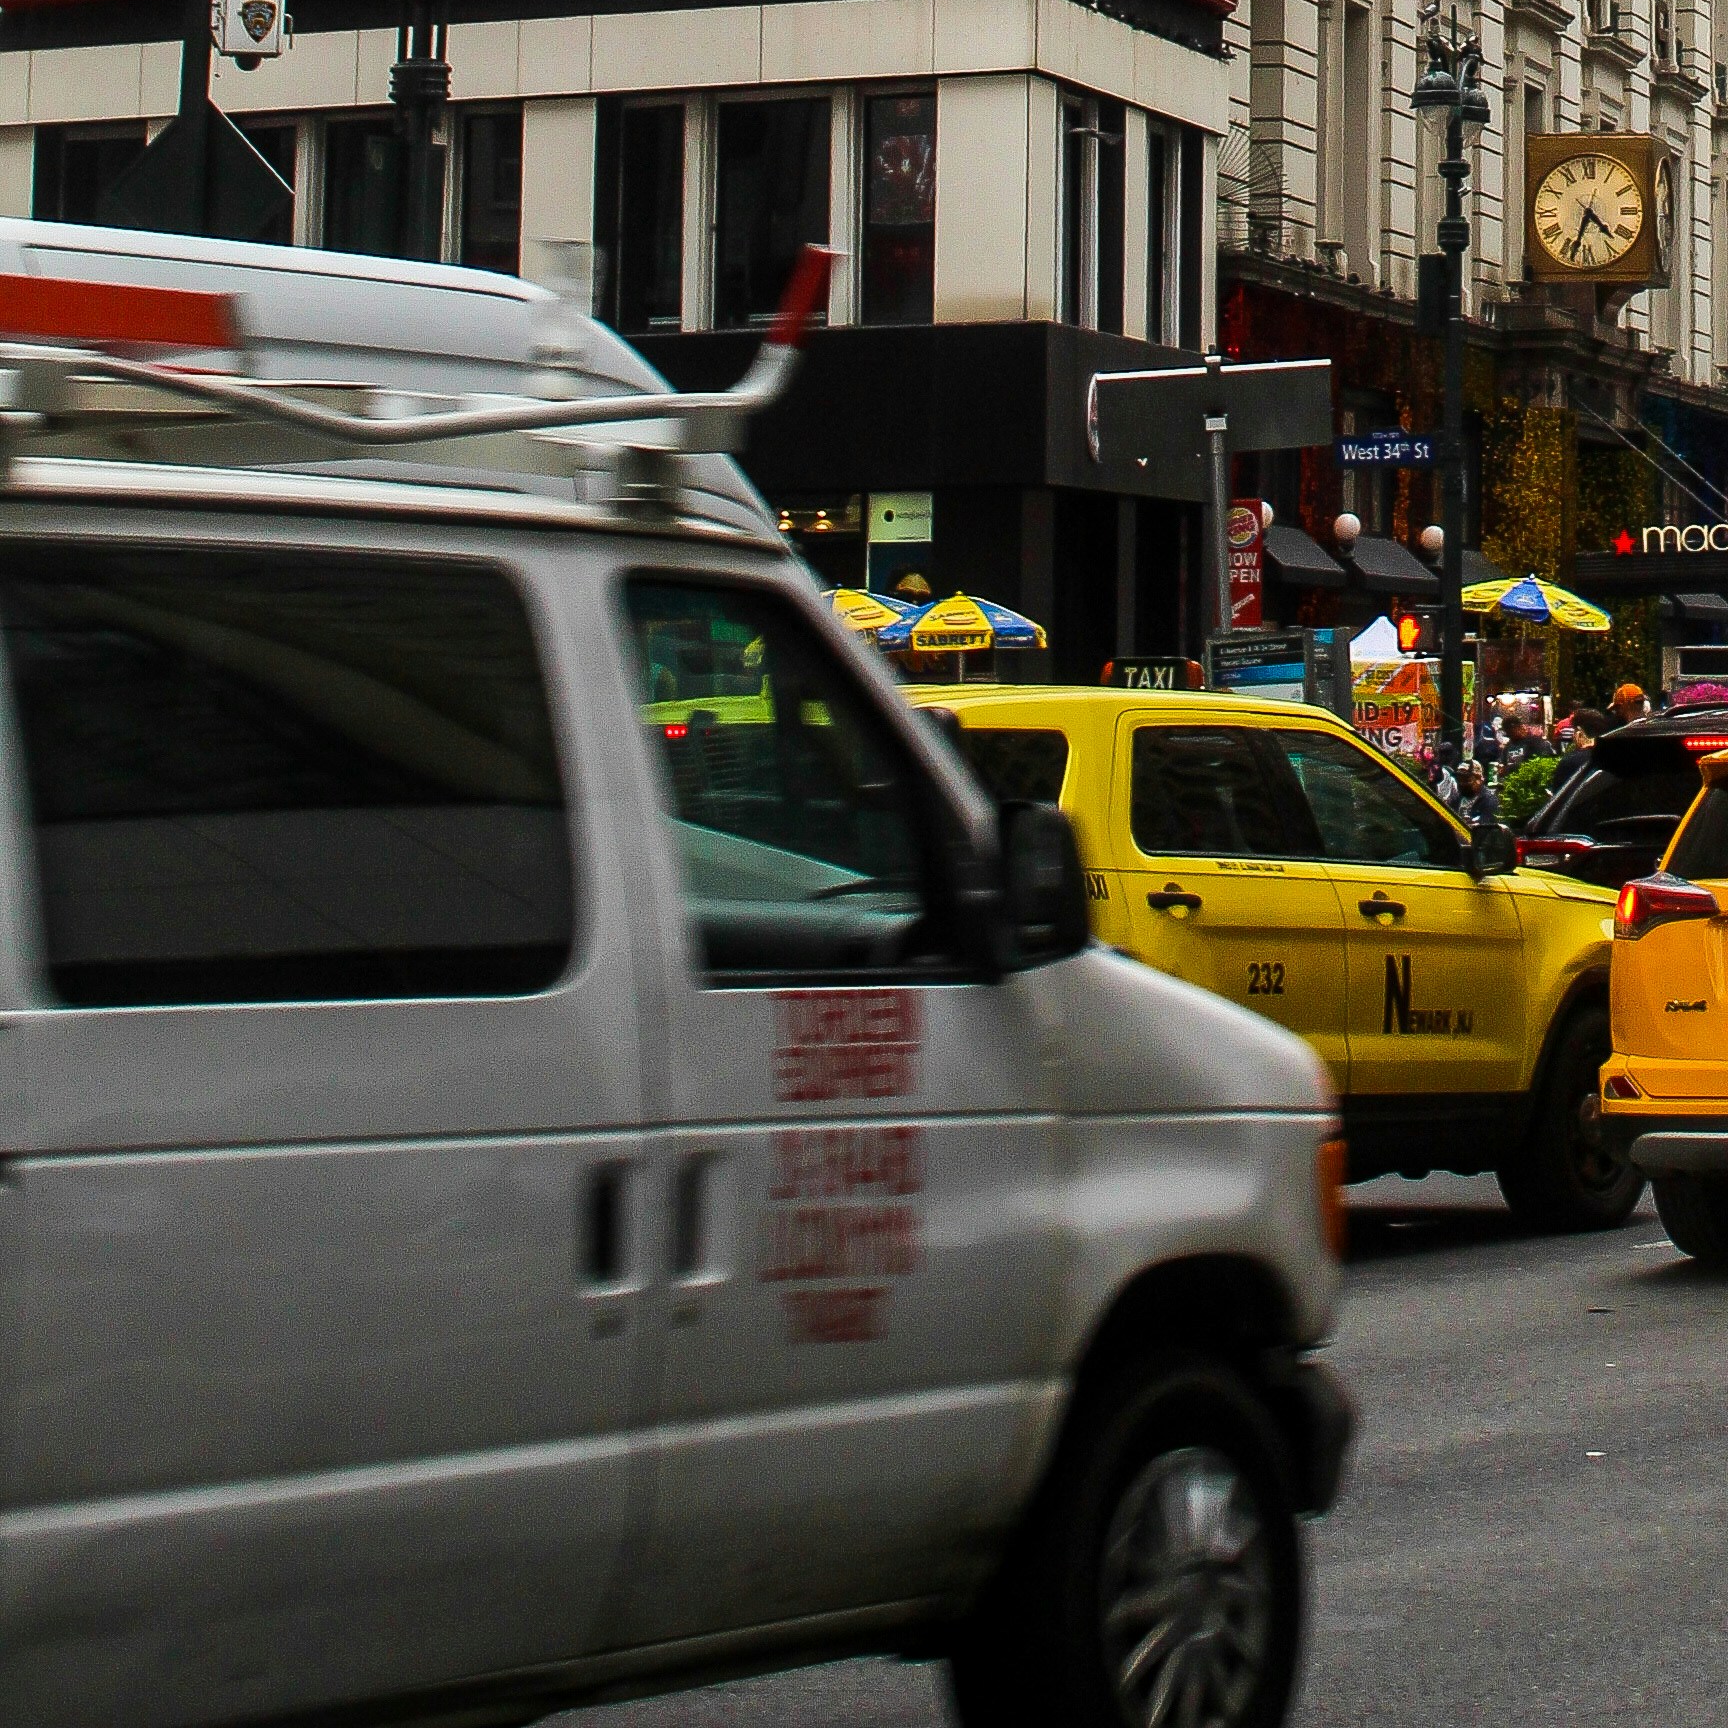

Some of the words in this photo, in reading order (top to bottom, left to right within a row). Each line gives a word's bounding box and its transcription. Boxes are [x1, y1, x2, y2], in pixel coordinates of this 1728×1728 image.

[1341, 444, 1380, 460] West
[1414, 442, 1429, 459] St
[1228, 552, 1258, 567] OW
[1228, 568, 1261, 583] PEN
[915, 633, 987, 646] SABRETT
[1124, 666, 1175, 689] TAXI
[1357, 701, 1413, 723] ID-19
[1248, 961, 1286, 995] 232
